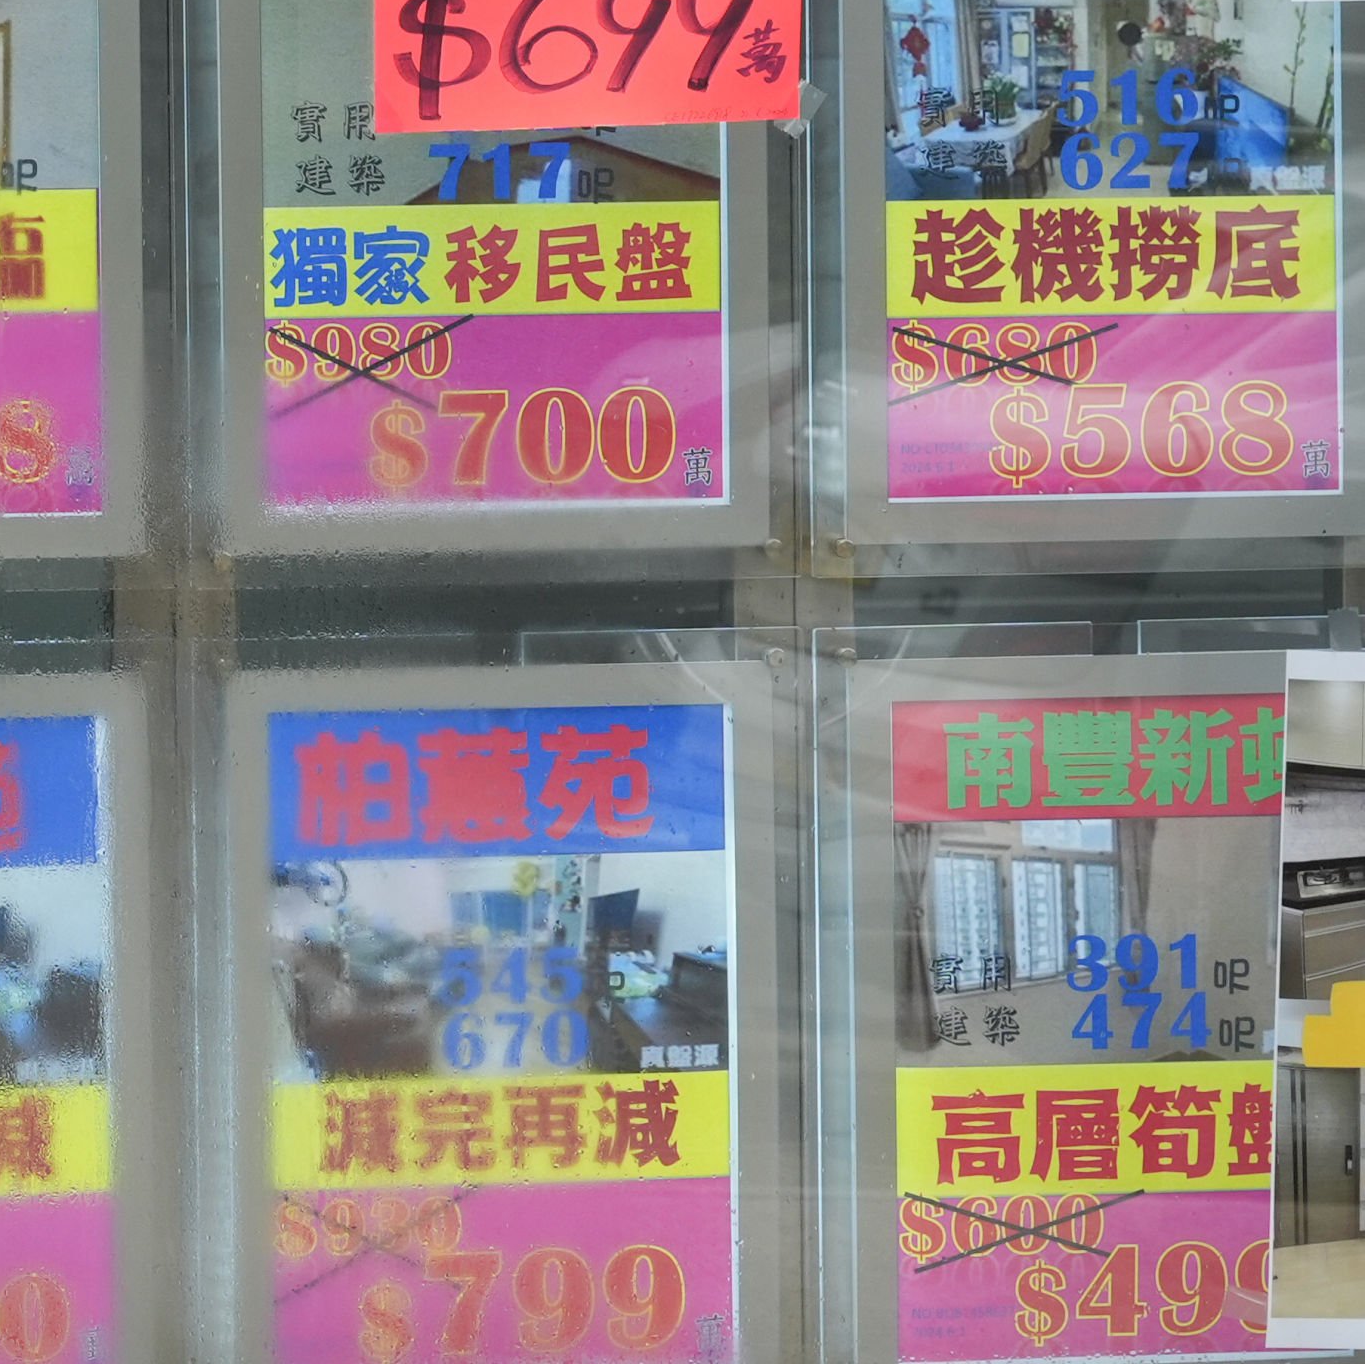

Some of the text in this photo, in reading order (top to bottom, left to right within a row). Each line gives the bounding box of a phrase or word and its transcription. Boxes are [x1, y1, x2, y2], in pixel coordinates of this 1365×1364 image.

[1056, 68, 1200, 128] 516
[427, 141, 571, 201] 717
[1059, 131, 1200, 192] 627
[910, 202, 1303, 306] 趁機撈底
[265, 318, 453, 385] $980
[890, 318, 1099, 391] $680
[370, 385, 678, 488] $700
[988, 379, 1296, 489] $568
[1066, 933, 1198, 992] 391
[1071, 991, 1213, 1050] 474
[898, 1192, 1106, 1263] $600
